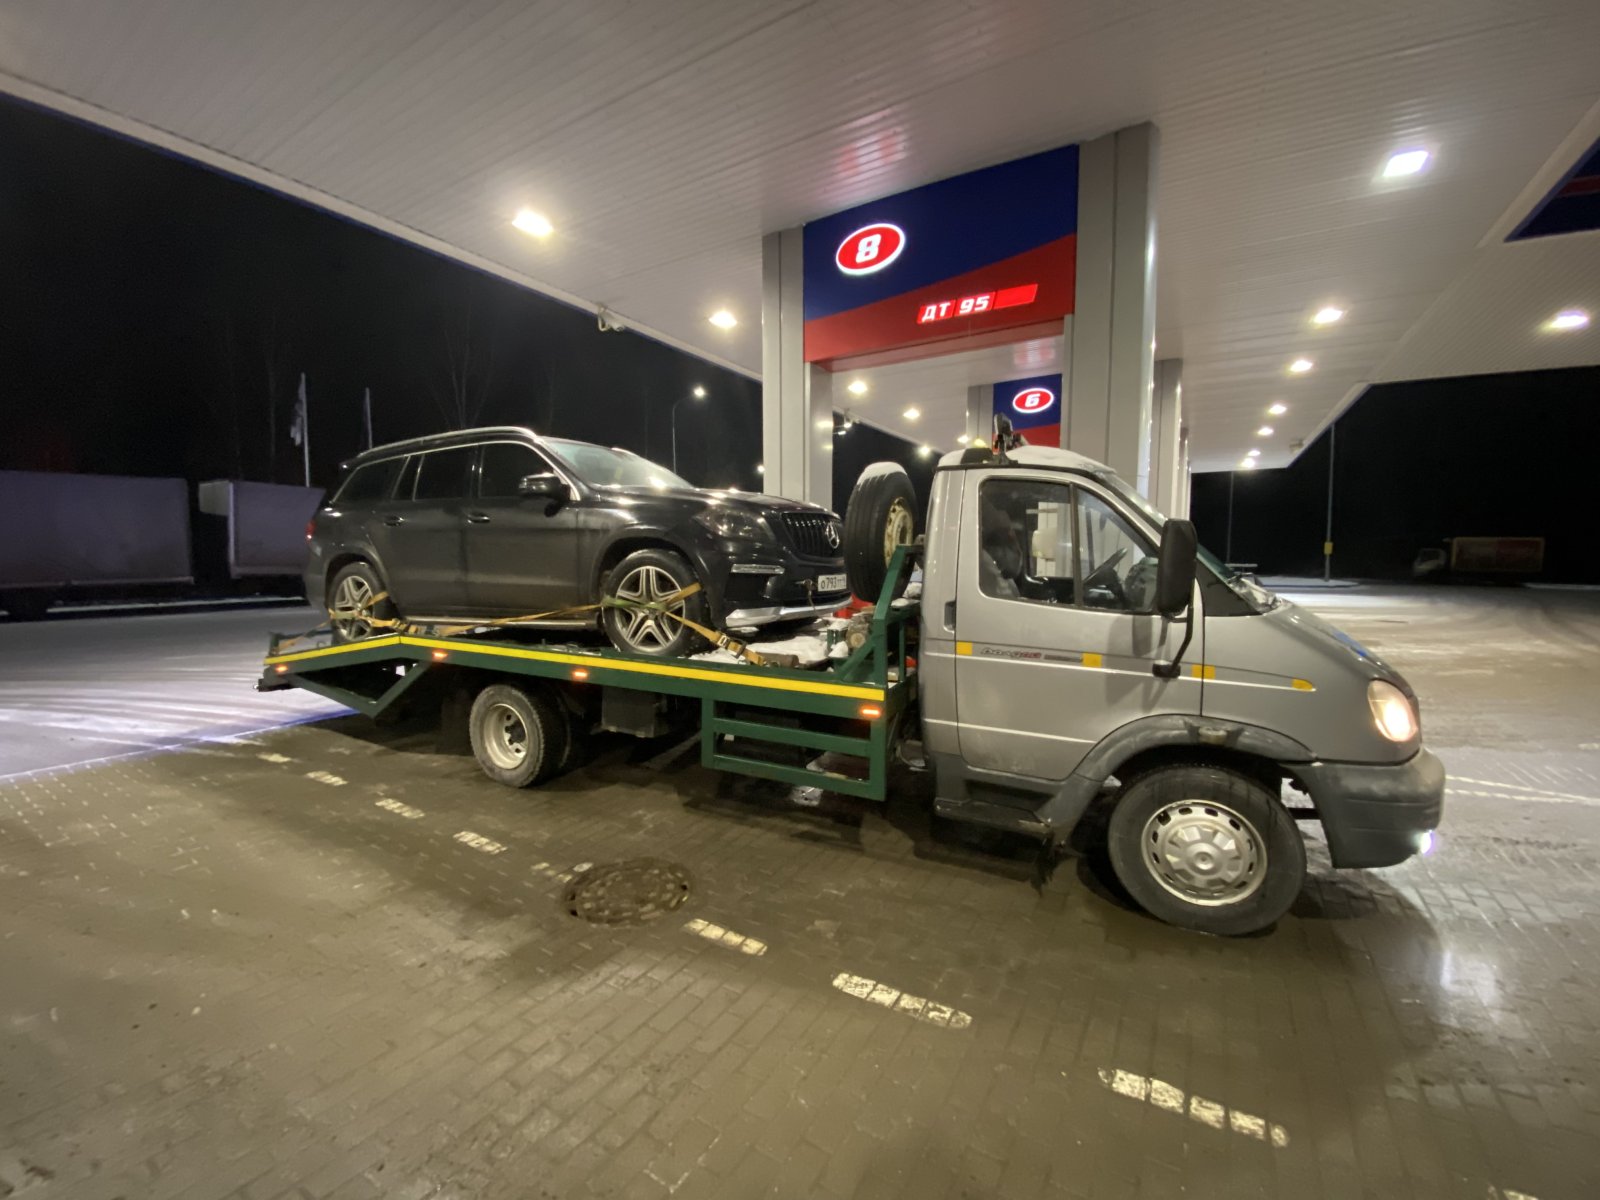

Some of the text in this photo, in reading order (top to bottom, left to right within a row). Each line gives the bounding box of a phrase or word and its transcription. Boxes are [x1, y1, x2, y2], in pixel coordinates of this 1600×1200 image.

[856, 233, 882, 264] 8
[921, 295, 990, 322] ДТ 95
[1024, 393, 1041, 408] 6
